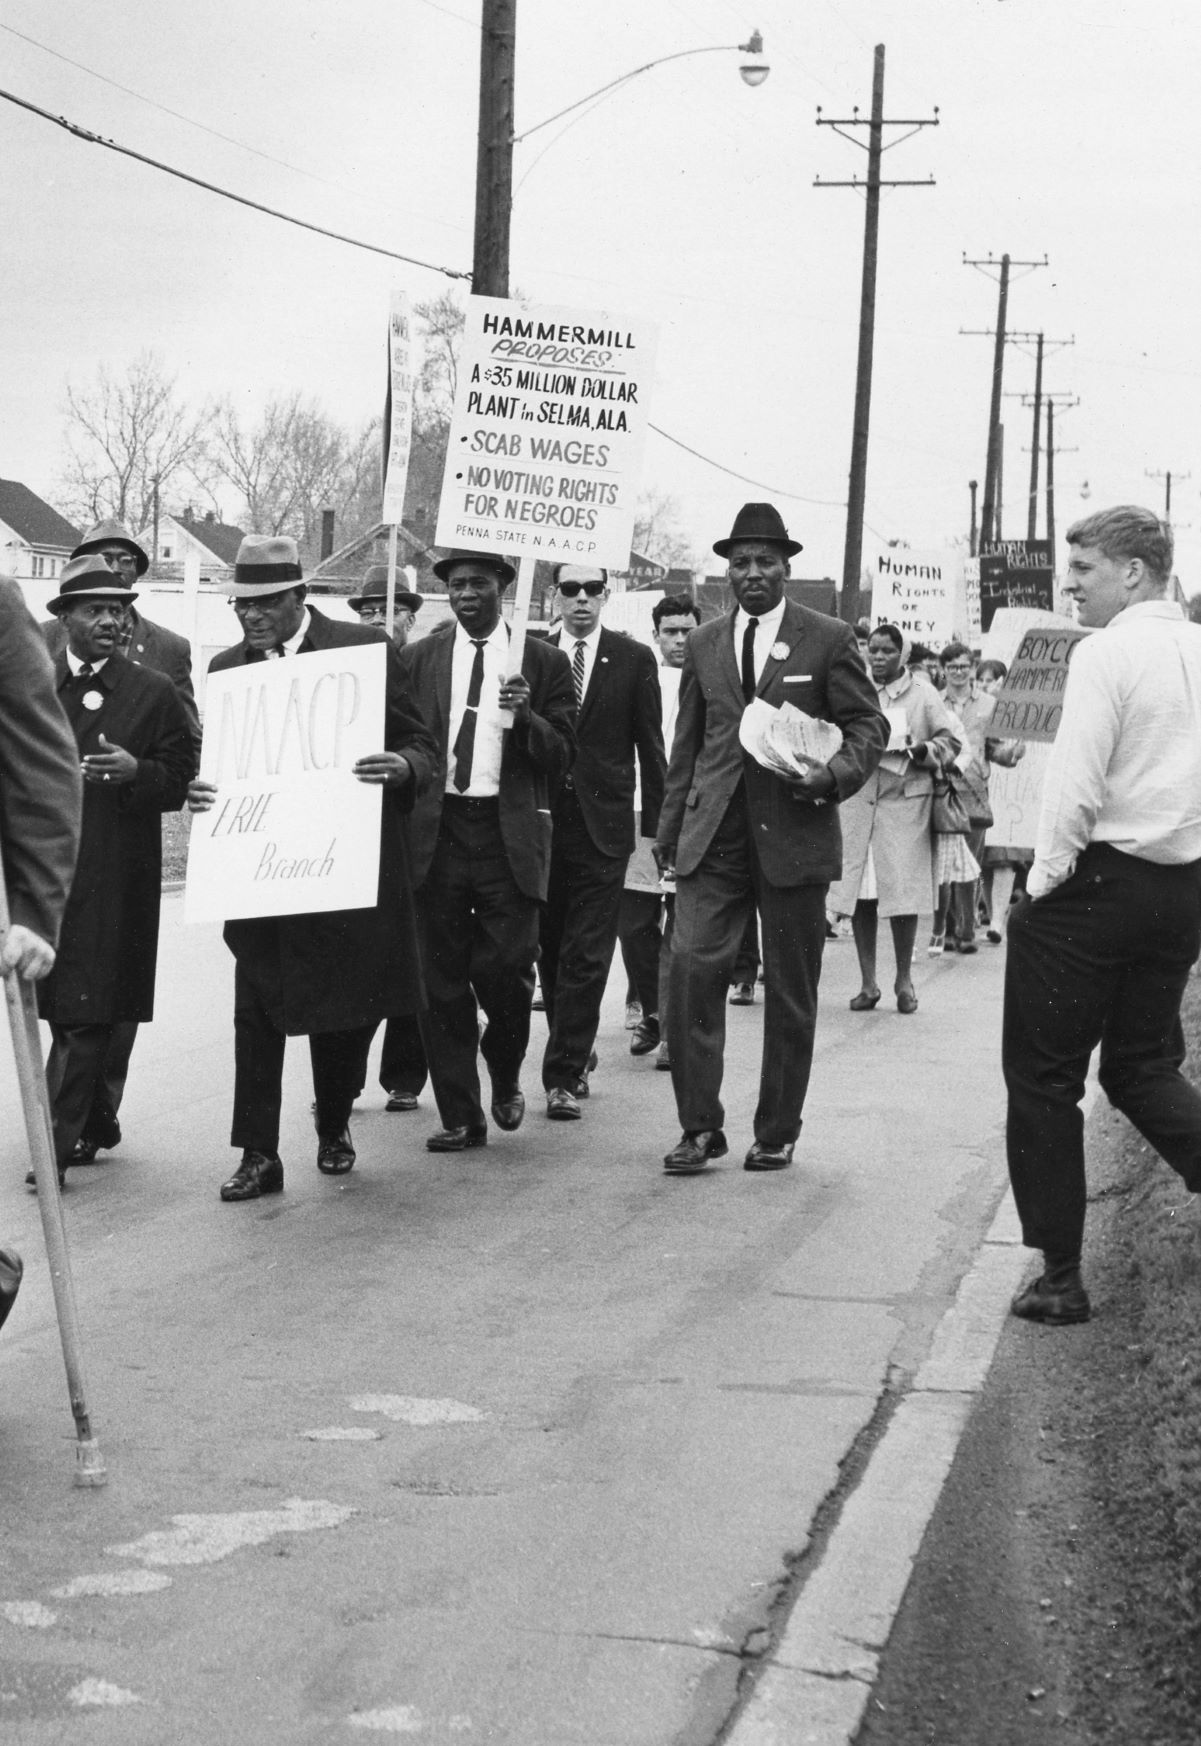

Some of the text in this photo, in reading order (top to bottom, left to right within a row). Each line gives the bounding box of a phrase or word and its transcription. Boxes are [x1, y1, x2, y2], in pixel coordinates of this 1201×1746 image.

[483, 313, 636, 349] HAMMERMILL
[471, 363, 638, 404] A $35 MILLION DOLLAR
[467, 391, 520, 419] PLANT
[521, 402, 534, 421] in
[470, 429, 610, 467] SCAB WAGES
[467, 465, 619, 505] NO VOTING RIGHTS
[464, 493, 598, 531] FOR NEGROES
[456, 524, 490, 538] PENNA
[496, 530, 527, 545] STATE
[216, 671, 361, 783] NAACP
[211, 792, 280, 837] ERIE
[254, 838, 336, 880] Branch
